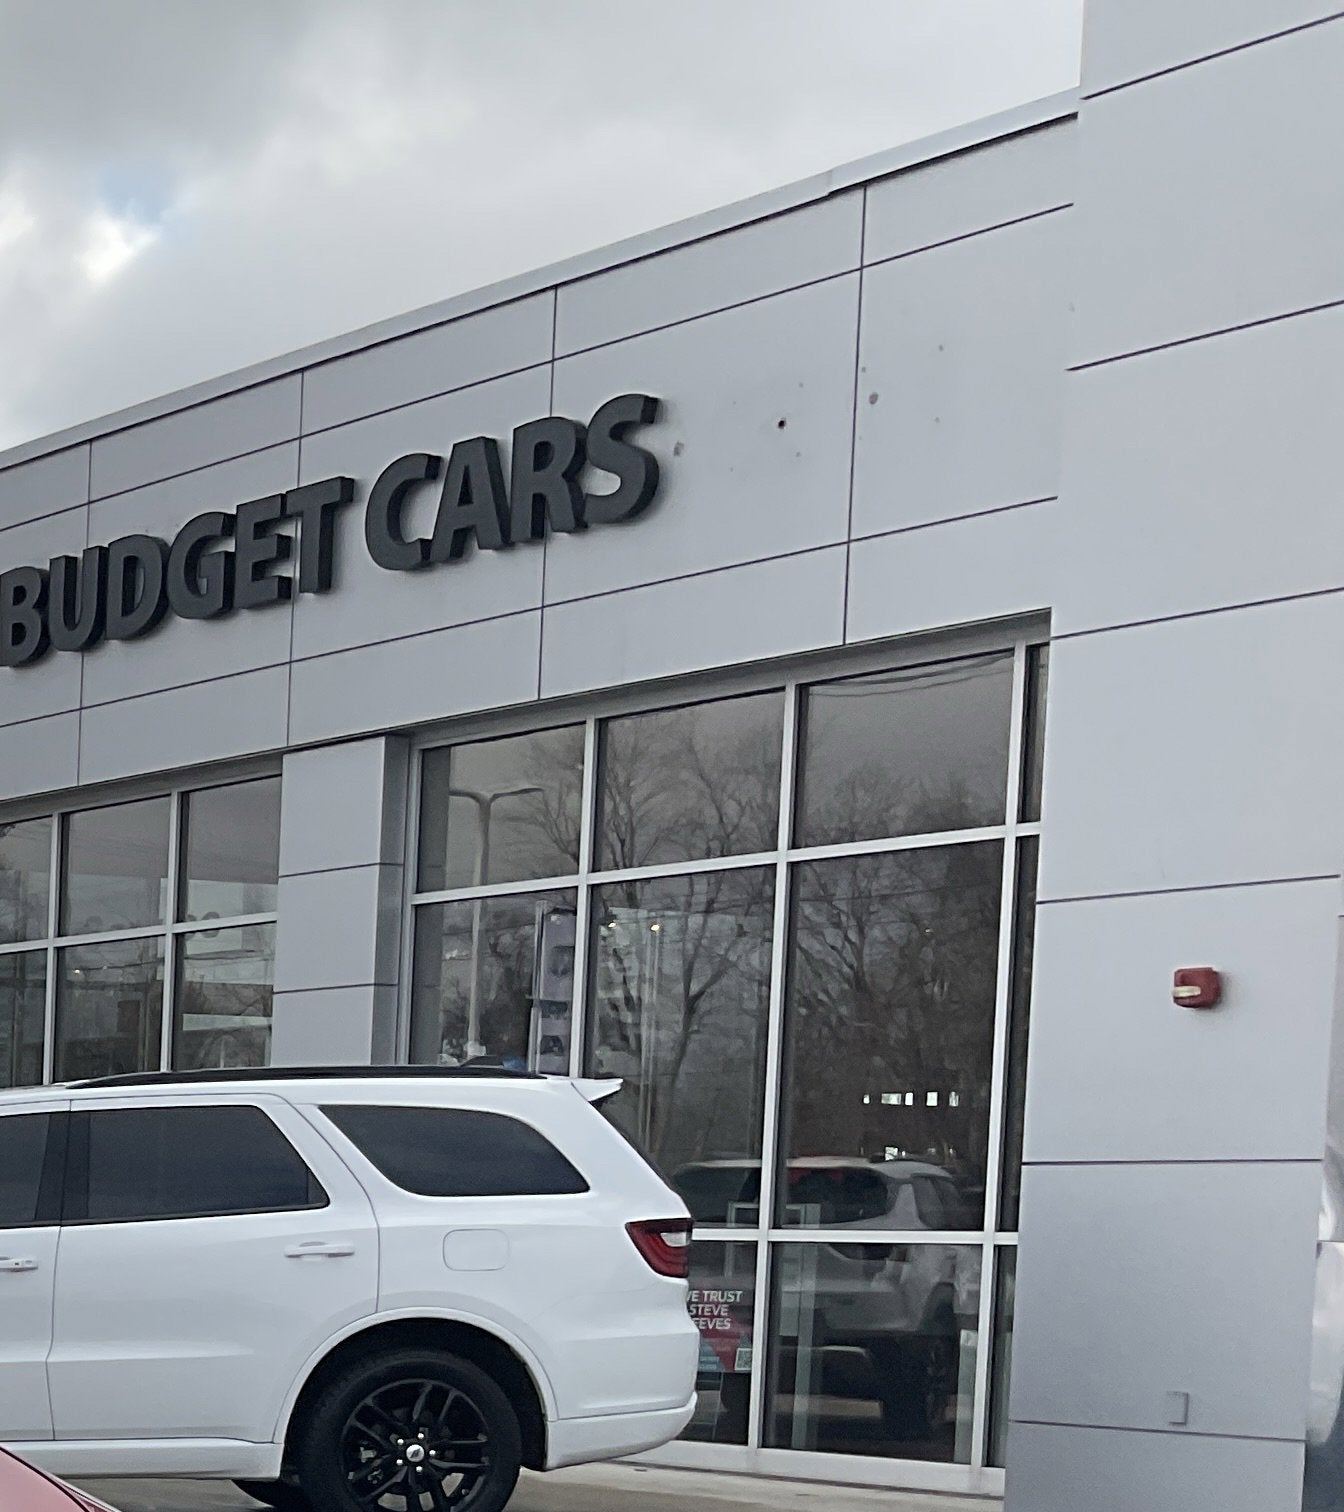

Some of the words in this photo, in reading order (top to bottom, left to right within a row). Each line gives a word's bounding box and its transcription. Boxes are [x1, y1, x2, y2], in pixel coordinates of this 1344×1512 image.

[365, 393, 659, 572] CARS
[703, 1290, 743, 1303] TRUST
[689, 1304, 730, 1316] STEVE
